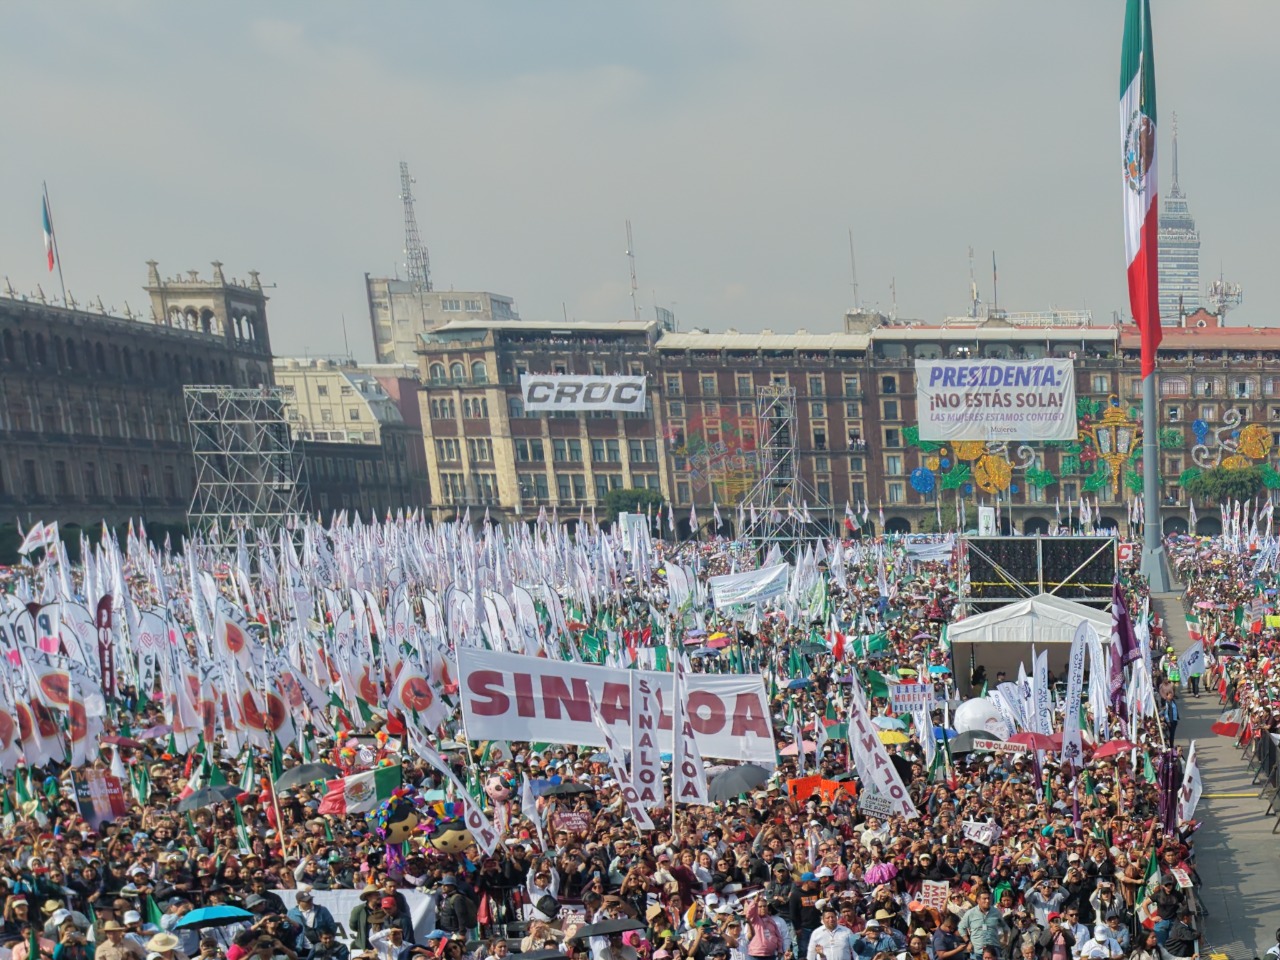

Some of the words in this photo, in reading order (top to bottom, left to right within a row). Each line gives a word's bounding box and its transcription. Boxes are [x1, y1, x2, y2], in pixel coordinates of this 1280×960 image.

[929, 365, 1063, 387] PRESIDENTA:
[527, 381, 643, 404] CROC
[930, 393, 960, 411] ¡NO
[965, 389, 1012, 408] ESTÁS
[1016, 392, 1064, 408] SOLA!
[930, 413, 945, 422] LAS
[947, 413, 984, 423] MUJERES
[985, 413, 1024, 422] ESTAMOS
[1026, 413, 1065, 421] CONTIGO
[990, 426, 1017, 435] Mujeres
[467, 670, 770, 738] SINALOA
[639, 680, 657, 802] SINALOA
[974, 740, 985, 748] YO
[993, 743, 1027, 752] CLAUDIA
